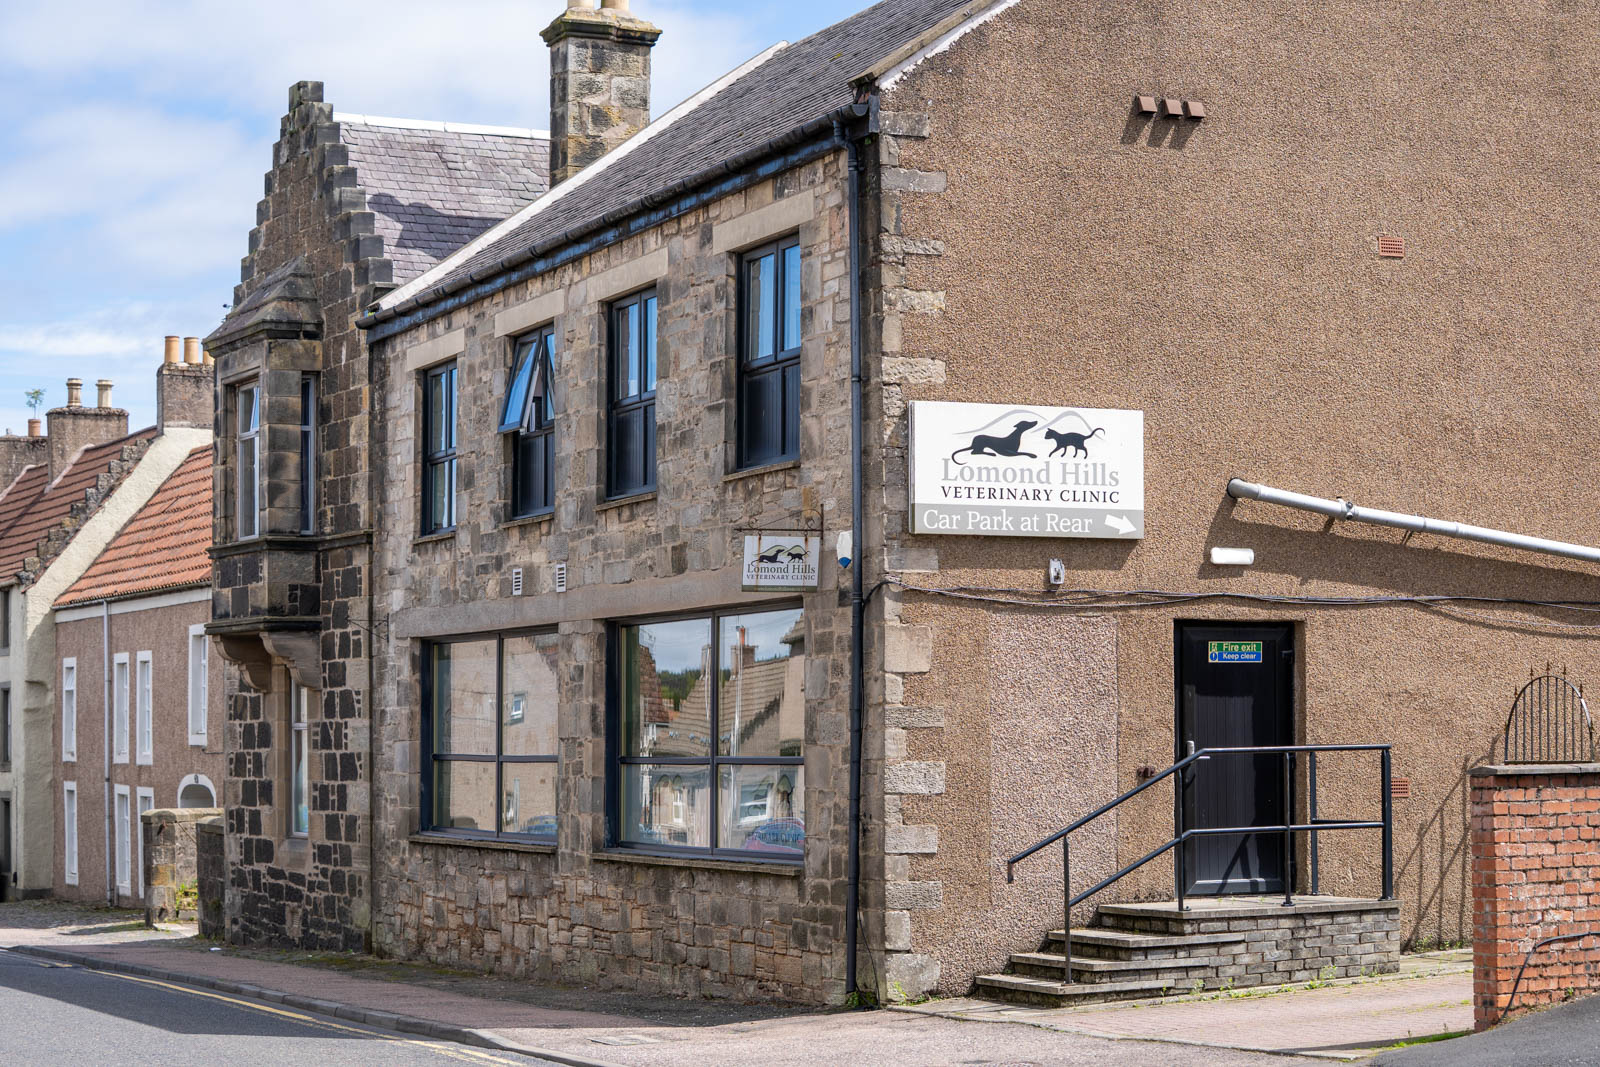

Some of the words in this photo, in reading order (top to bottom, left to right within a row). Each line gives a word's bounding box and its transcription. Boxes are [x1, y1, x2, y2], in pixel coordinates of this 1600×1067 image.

[941, 458, 1051, 486] Lomond
[1061, 463, 1120, 487] Hills
[941, 486, 1053, 502] VETERINARY
[1060, 489, 1120, 504] CLINIC
[923, 509, 961, 530] Car
[967, 509, 1018, 531] Park
[1020, 514, 1040, 532] at
[1045, 513, 1093, 533] Rear
[747, 563, 789, 574] Lomond
[792, 564, 816, 574] Hills
[1222, 643, 1239, 652] Fire
[1241, 643, 1257, 652] exit
[1222, 652, 1239, 660] Keep
[1240, 652, 1257, 660] clear
